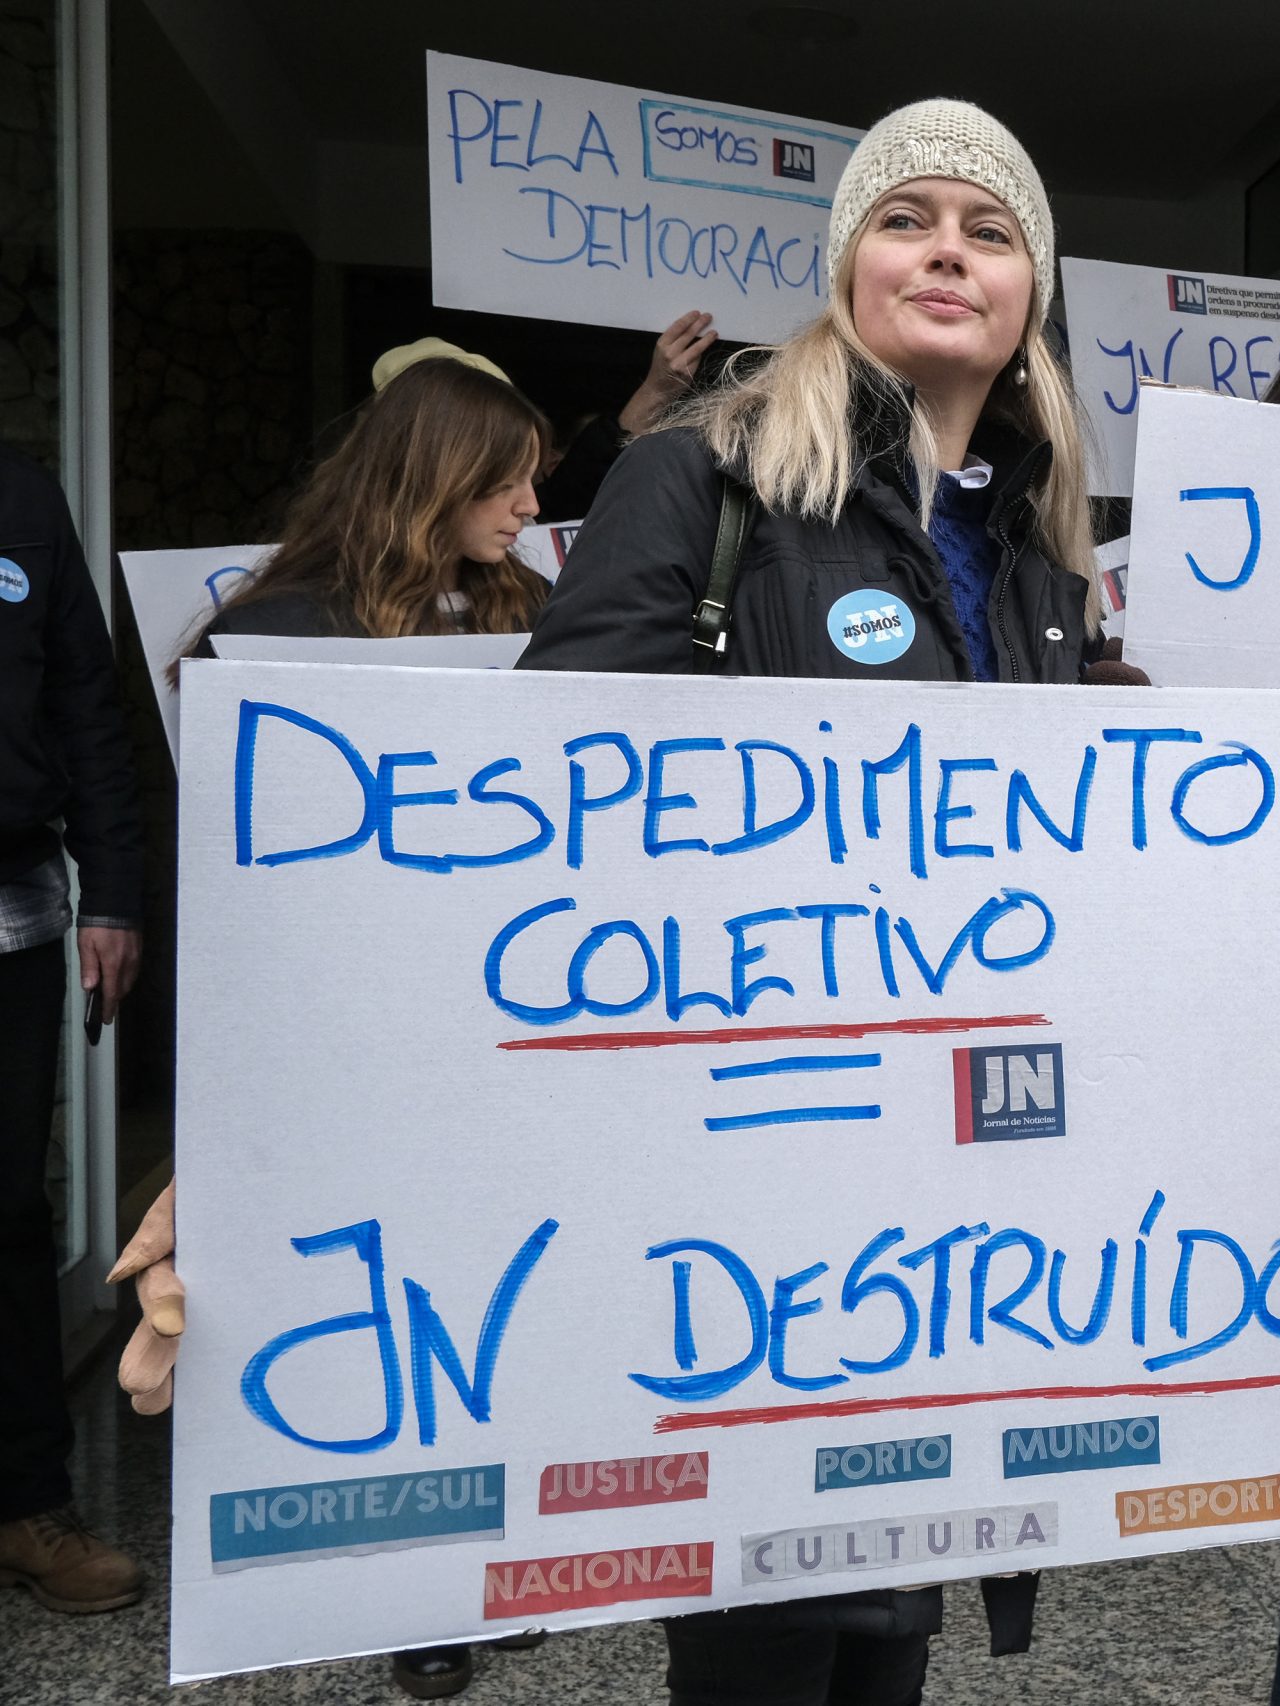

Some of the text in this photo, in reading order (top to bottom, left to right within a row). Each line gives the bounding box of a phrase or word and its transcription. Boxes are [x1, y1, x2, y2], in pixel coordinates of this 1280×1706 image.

[446, 88, 619, 184] PELA
[655, 110, 812, 172] SOMOS JN
[503, 187, 829, 298] DEMOCRACI
[1177, 279, 1204, 305] JN
[1206, 285, 1238, 296] Diretiva
[1239, 289, 1254, 298] que
[1207, 296, 1236, 306] ordens
[1208, 307, 1222, 315] em
[1222, 308, 1260, 318] suspenso
[842, 614, 902, 639] #SOMOS
[981, 1053, 1056, 1114] JN
[982, 1119, 1009, 1128] Jornal
[1010, 1118, 1021, 1126] de
[240, 1216, 559, 1457] JN
[818, 1436, 949, 1485] PORTO
[1006, 1417, 1156, 1465] MUNDO
[545, 1453, 708, 1501] JUSTIÇA
[233, 1471, 498, 1535] NORTE/SUL
[753, 1511, 1047, 1575] CULTURA
[485, 1544, 710, 1604] NACIONAL
